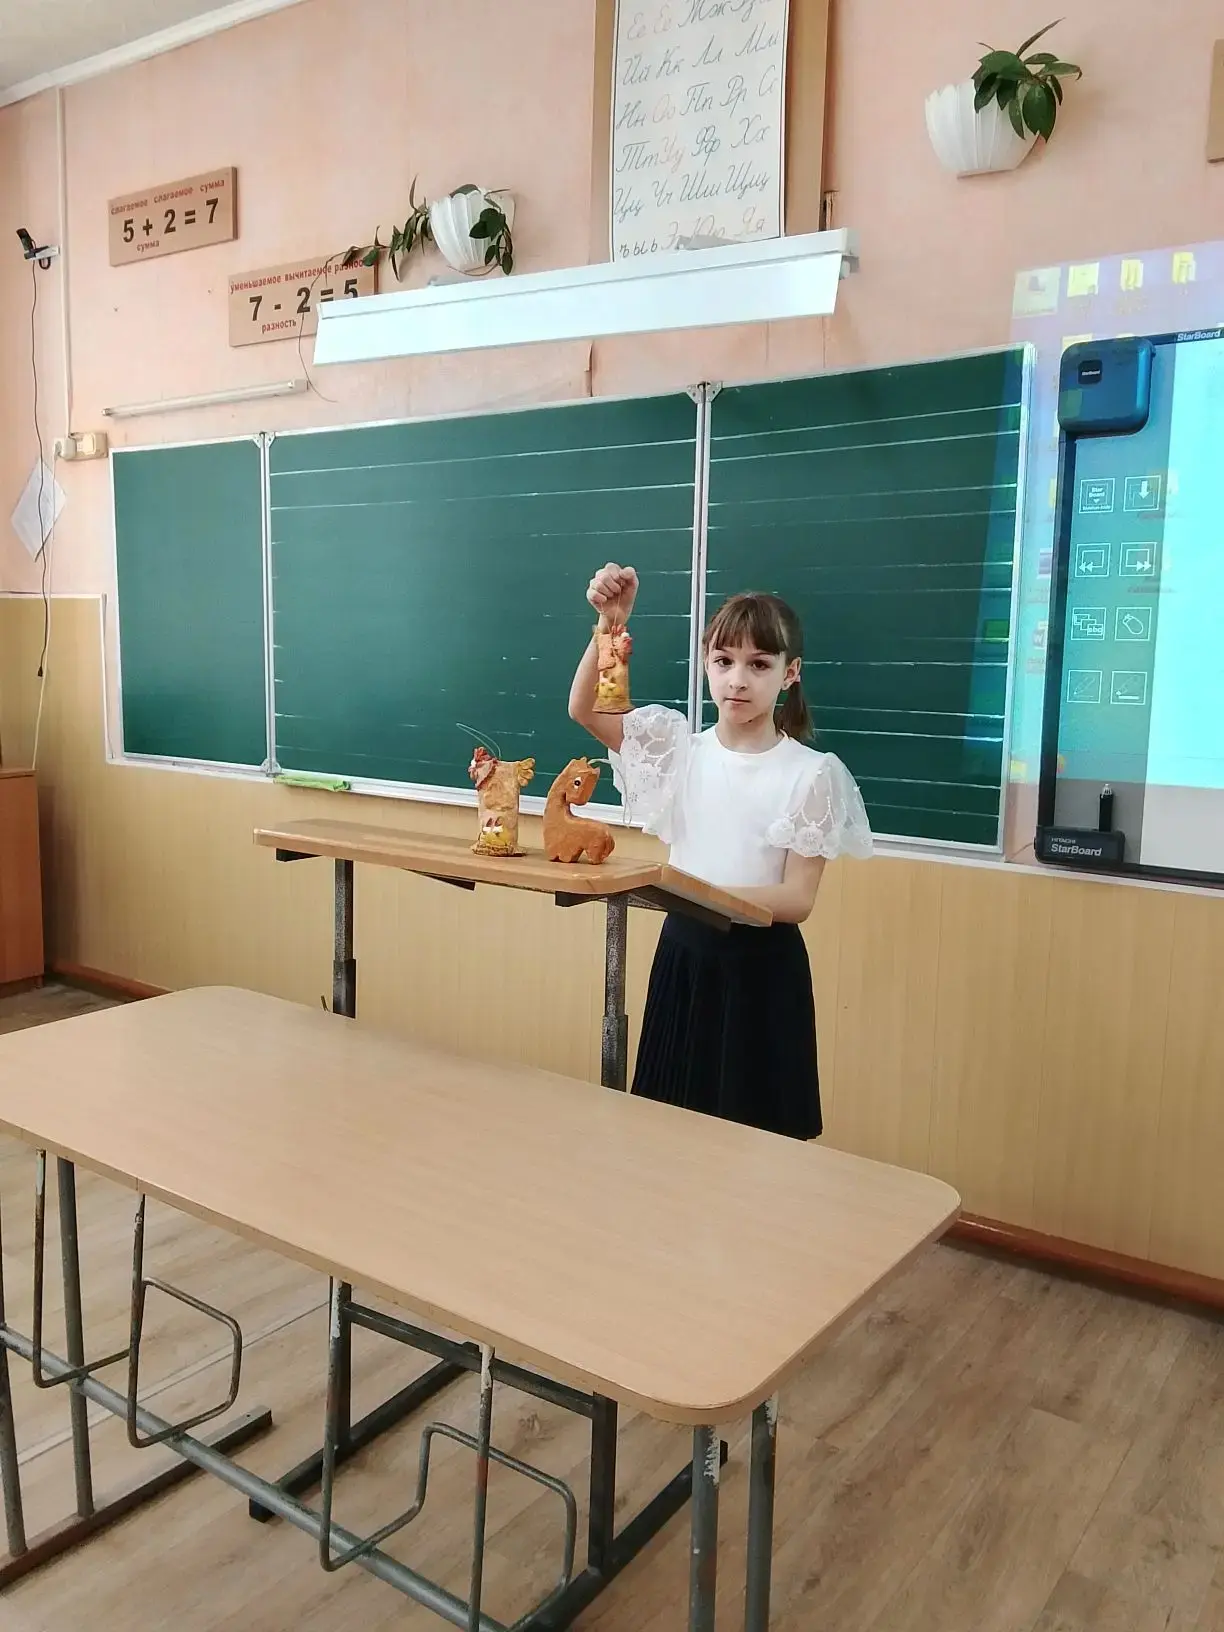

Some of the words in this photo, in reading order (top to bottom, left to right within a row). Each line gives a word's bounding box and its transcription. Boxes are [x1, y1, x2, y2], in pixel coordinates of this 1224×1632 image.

[692, 34, 723, 68] Лл
[734, 21, 780, 57] Мм
[616, 99, 648, 131] Нн
[679, 81, 713, 116] Пп
[719, 74, 748, 118] Рр
[615, 140, 659, 173] Тт
[730, 114, 771, 149] Хх
[199, 179, 225, 193] сумма
[613, 186, 645, 224] Цц
[679, 169, 723, 203] Шш
[724, 160, 771, 200] Щщ
[136, 240, 160, 253] сумма
[230, 274, 281, 295] уменьшаемое
[261, 318, 297, 334] разность
[1176, 329, 1222, 342] StarBoard
[1050, 843, 1102, 857] StarBoard
